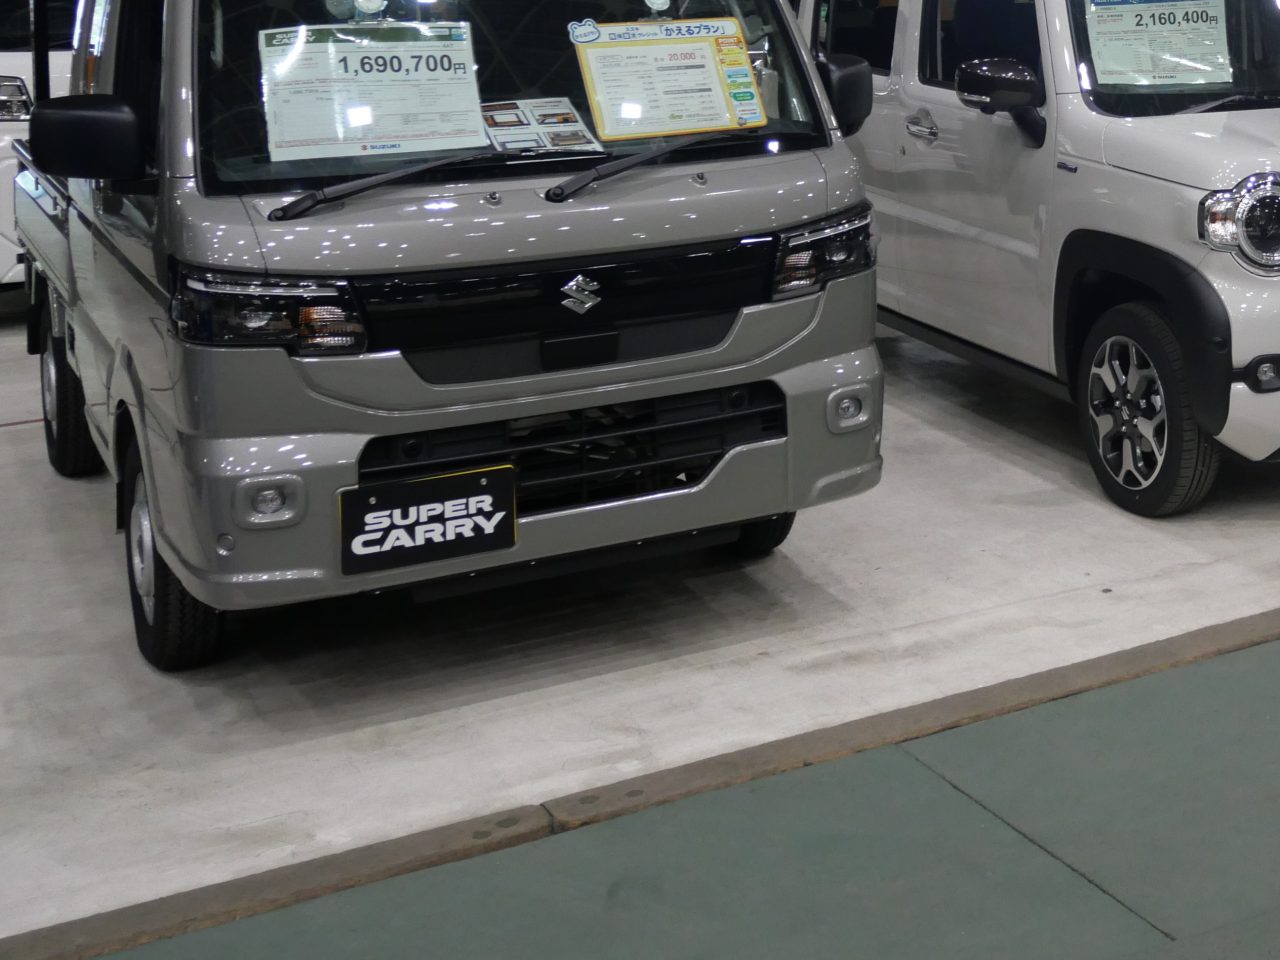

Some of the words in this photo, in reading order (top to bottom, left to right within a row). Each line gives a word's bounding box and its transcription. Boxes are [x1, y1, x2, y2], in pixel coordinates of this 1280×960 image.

[1135, 10, 1218, 28] 2,160,400円
[338, 54, 467, 77] 1,690,700円
[364, 494, 494, 531] SUPER
[351, 511, 507, 555] CARRY
